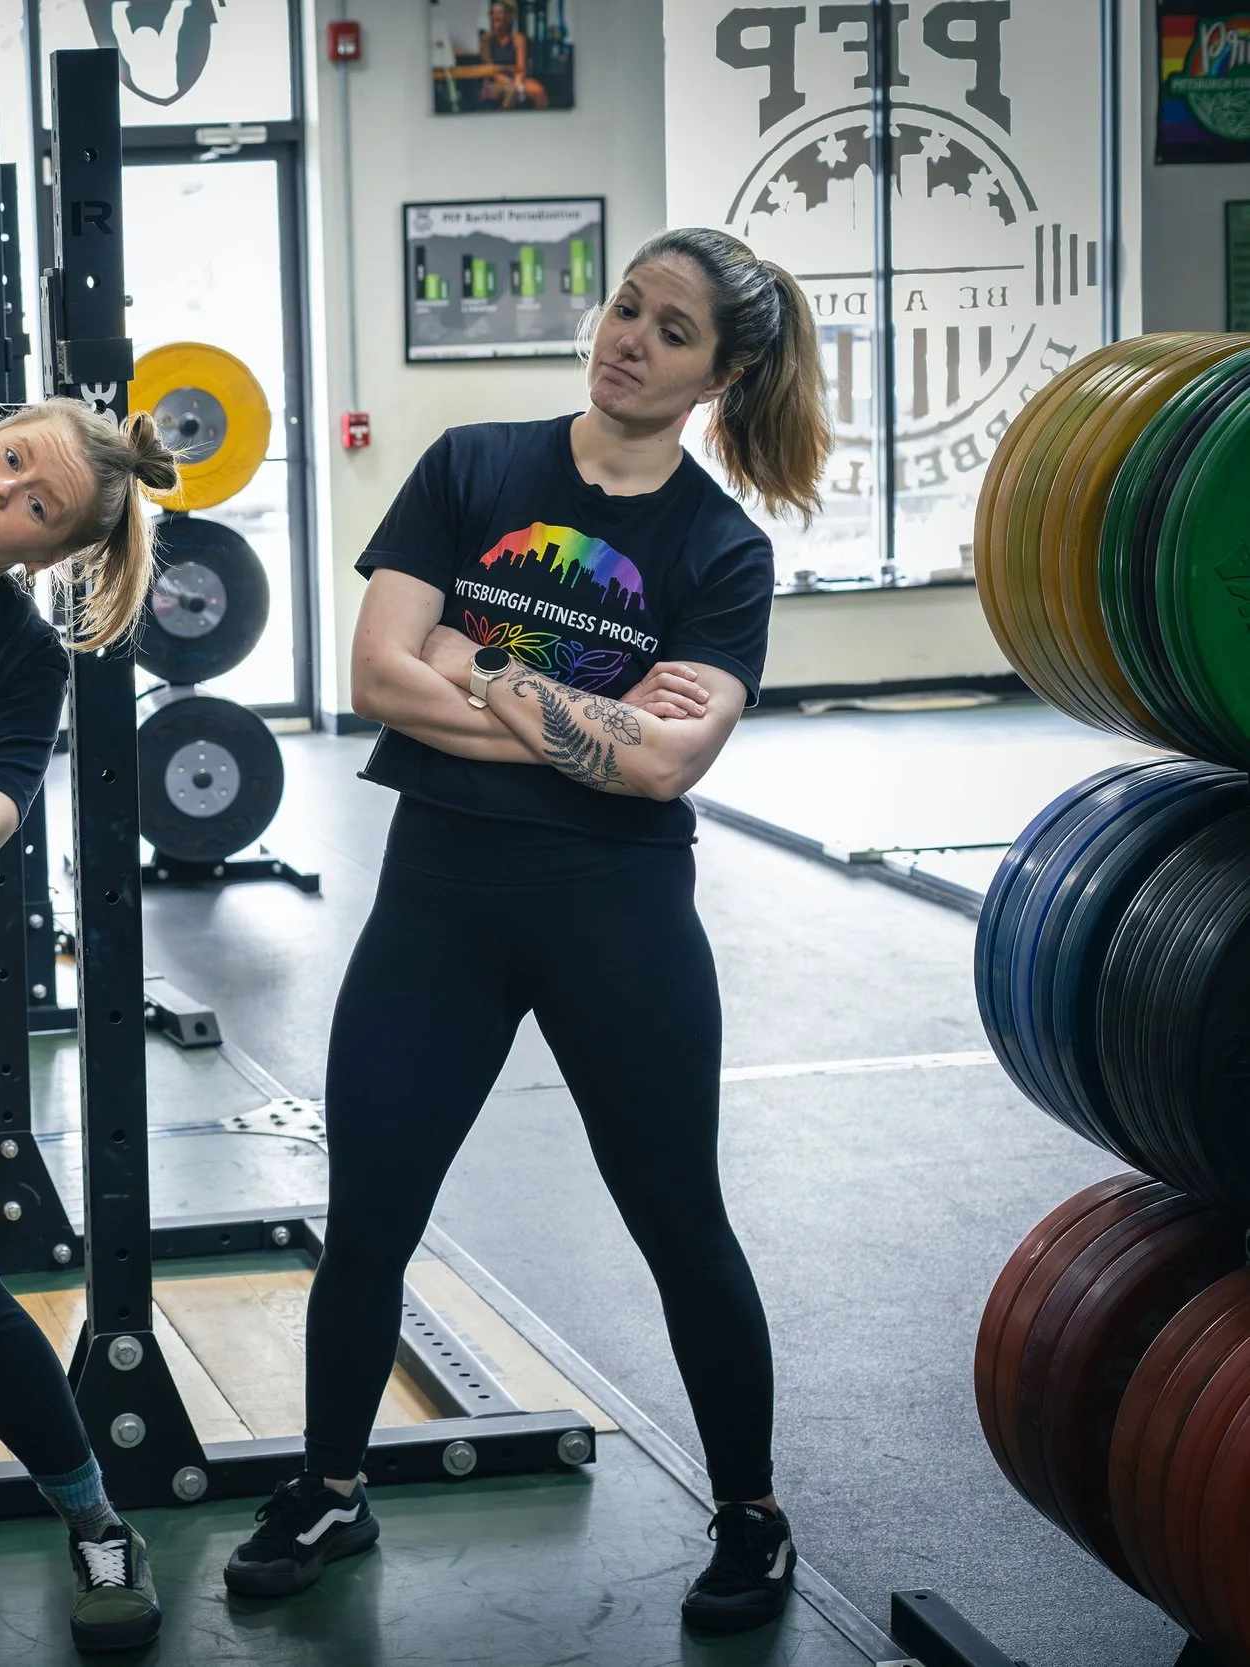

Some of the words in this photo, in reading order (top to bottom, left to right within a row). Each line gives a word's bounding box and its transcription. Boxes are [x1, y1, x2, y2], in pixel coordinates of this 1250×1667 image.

[1200, 20, 1250, 74] Pri
[70, 200, 114, 236] R
[533, 599, 598, 633] FITNESS
